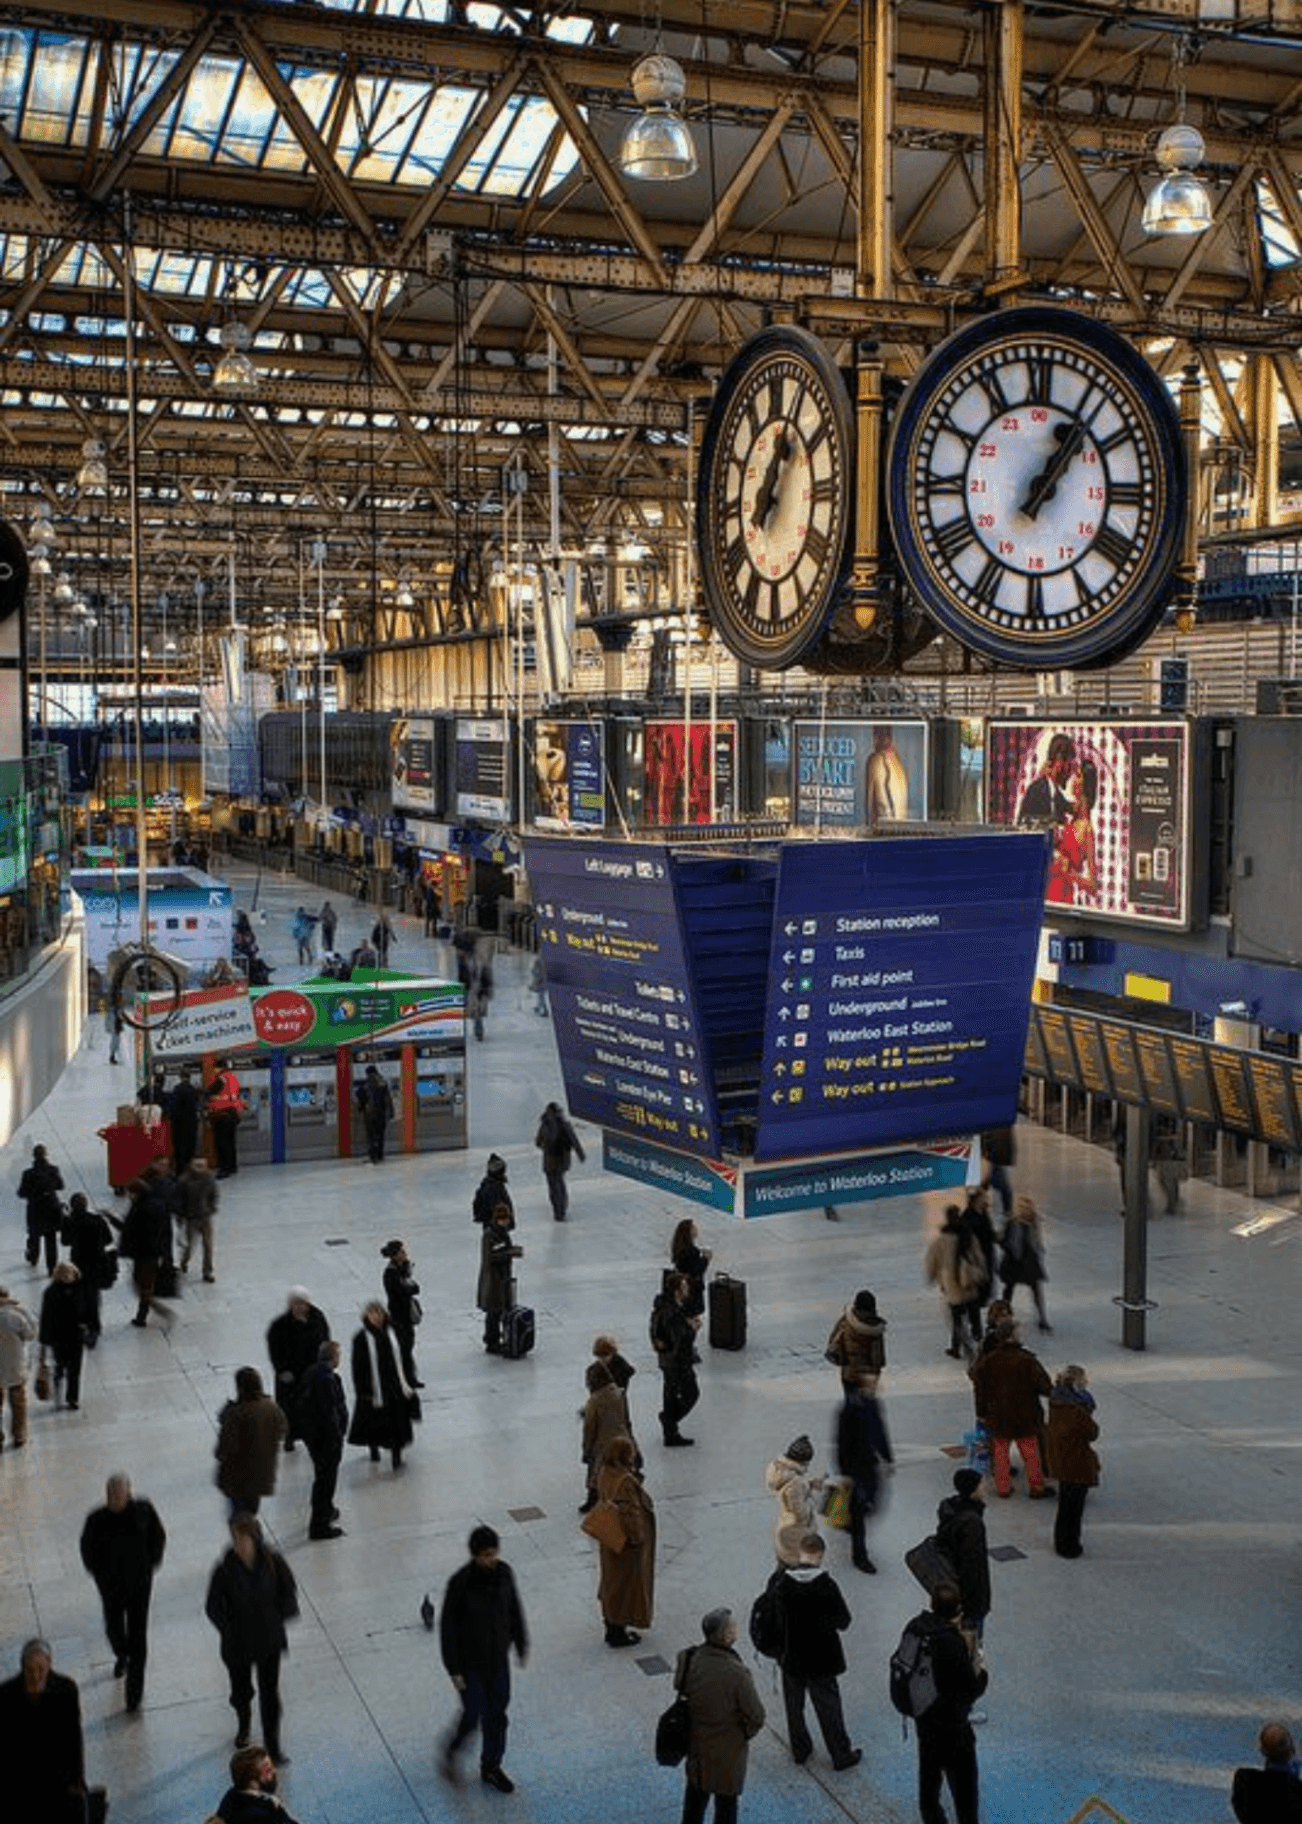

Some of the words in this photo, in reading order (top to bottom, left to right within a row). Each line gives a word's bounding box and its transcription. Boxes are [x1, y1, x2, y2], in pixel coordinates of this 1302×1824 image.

[1002, 418, 1021, 431] 23
[970, 480, 987, 493] 21
[1087, 487, 1105, 501] 15
[977, 514, 995, 528] 20
[1078, 523, 1094, 536] 16
[999, 541, 1015, 554] 19
[1059, 547, 1074, 559] 17
[1028, 557, 1045, 570] 18
[835, 917, 881, 933] Station
[882, 914, 940, 930] reception
[835, 946, 866, 961] Taxis
[1069, 941, 1084, 961] 11
[830, 974, 859, 988] First
[860, 971, 881, 986] aid
[881, 970, 914, 988] point
[828, 996, 908, 1017] Underground
[194, 1023, 253, 1042] machines
[826, 1026, 881, 1043] Waterloo
[883, 1023, 909, 1037] East
[911, 1020, 953, 1035] Station
[755, 1182, 812, 1202] Welcome
[814, 1181, 828, 1194] to
[830, 1172, 887, 1192] Waterloo
[888, 1165, 934, 1184] Station
